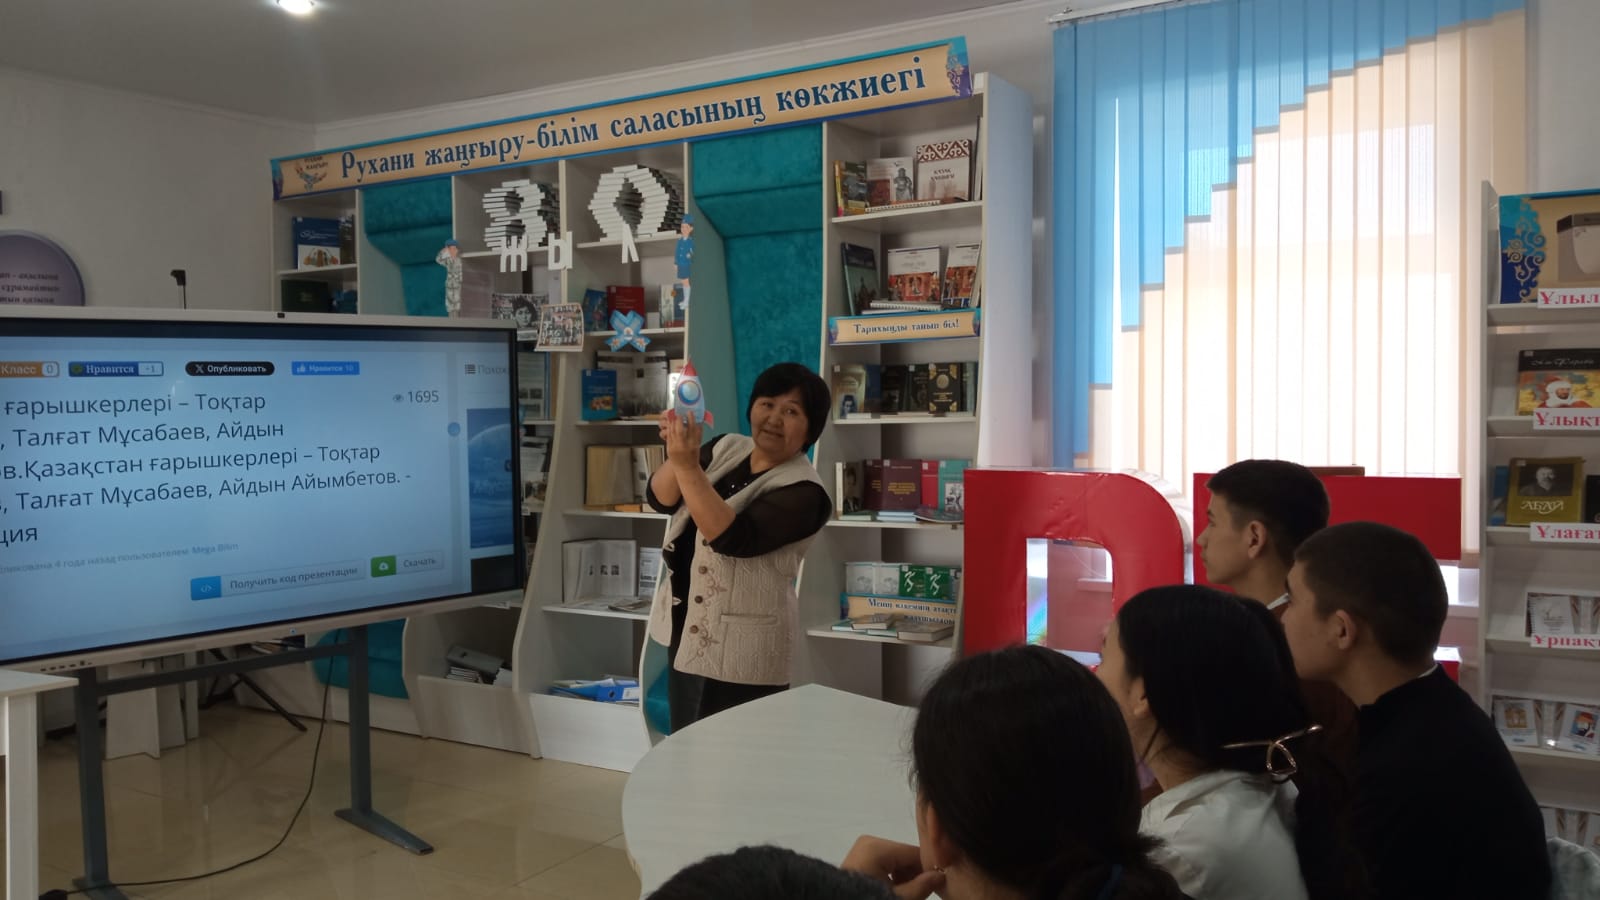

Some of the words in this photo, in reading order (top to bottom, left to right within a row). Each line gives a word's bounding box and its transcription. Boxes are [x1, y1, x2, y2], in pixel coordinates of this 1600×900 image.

[341, 151, 415, 183] Рухани
[425, 117, 599, 169] жаңғыру-білім
[610, 95, 766, 138] саласының
[776, 56, 926, 112] көкжиегі
[853, 323, 908, 335] Тарихыңды
[912, 322, 940, 331] танып
[943, 319, 960, 329] біл!
[1, 364, 37, 375] Класс
[86, 364, 134, 375] Нравится
[207, 363, 267, 374] Опубликовать
[407, 390, 440, 403] 1695
[4, 395, 172, 420] ғарышкерлері
[194, 393, 266, 412] Тоқтар
[12, 428, 91, 447] Талғат
[99, 423, 210, 447] Мұсабаев,
[216, 421, 284, 440] Айдын
[0, 458, 143, 482] в.Қазақстан
[150, 448, 298, 474] ғарышкерлері
[317, 446, 381, 465] Тоқтар
[16, 491, 94, 510] Талғат
[101, 483, 213, 508] Мұсабаев,
[218, 478, 286, 497] Айдын
[291, 471, 401, 491] Айымбетов.
[63, 559, 86, 568] года
[87, 556, 117, 566] назад
[118, 549, 189, 562] пользователем
[403, 557, 437, 568] Скачать
[230, 578, 278, 590] Получить
[279, 575, 297, 585] код
[298, 567, 358, 582] презентации
